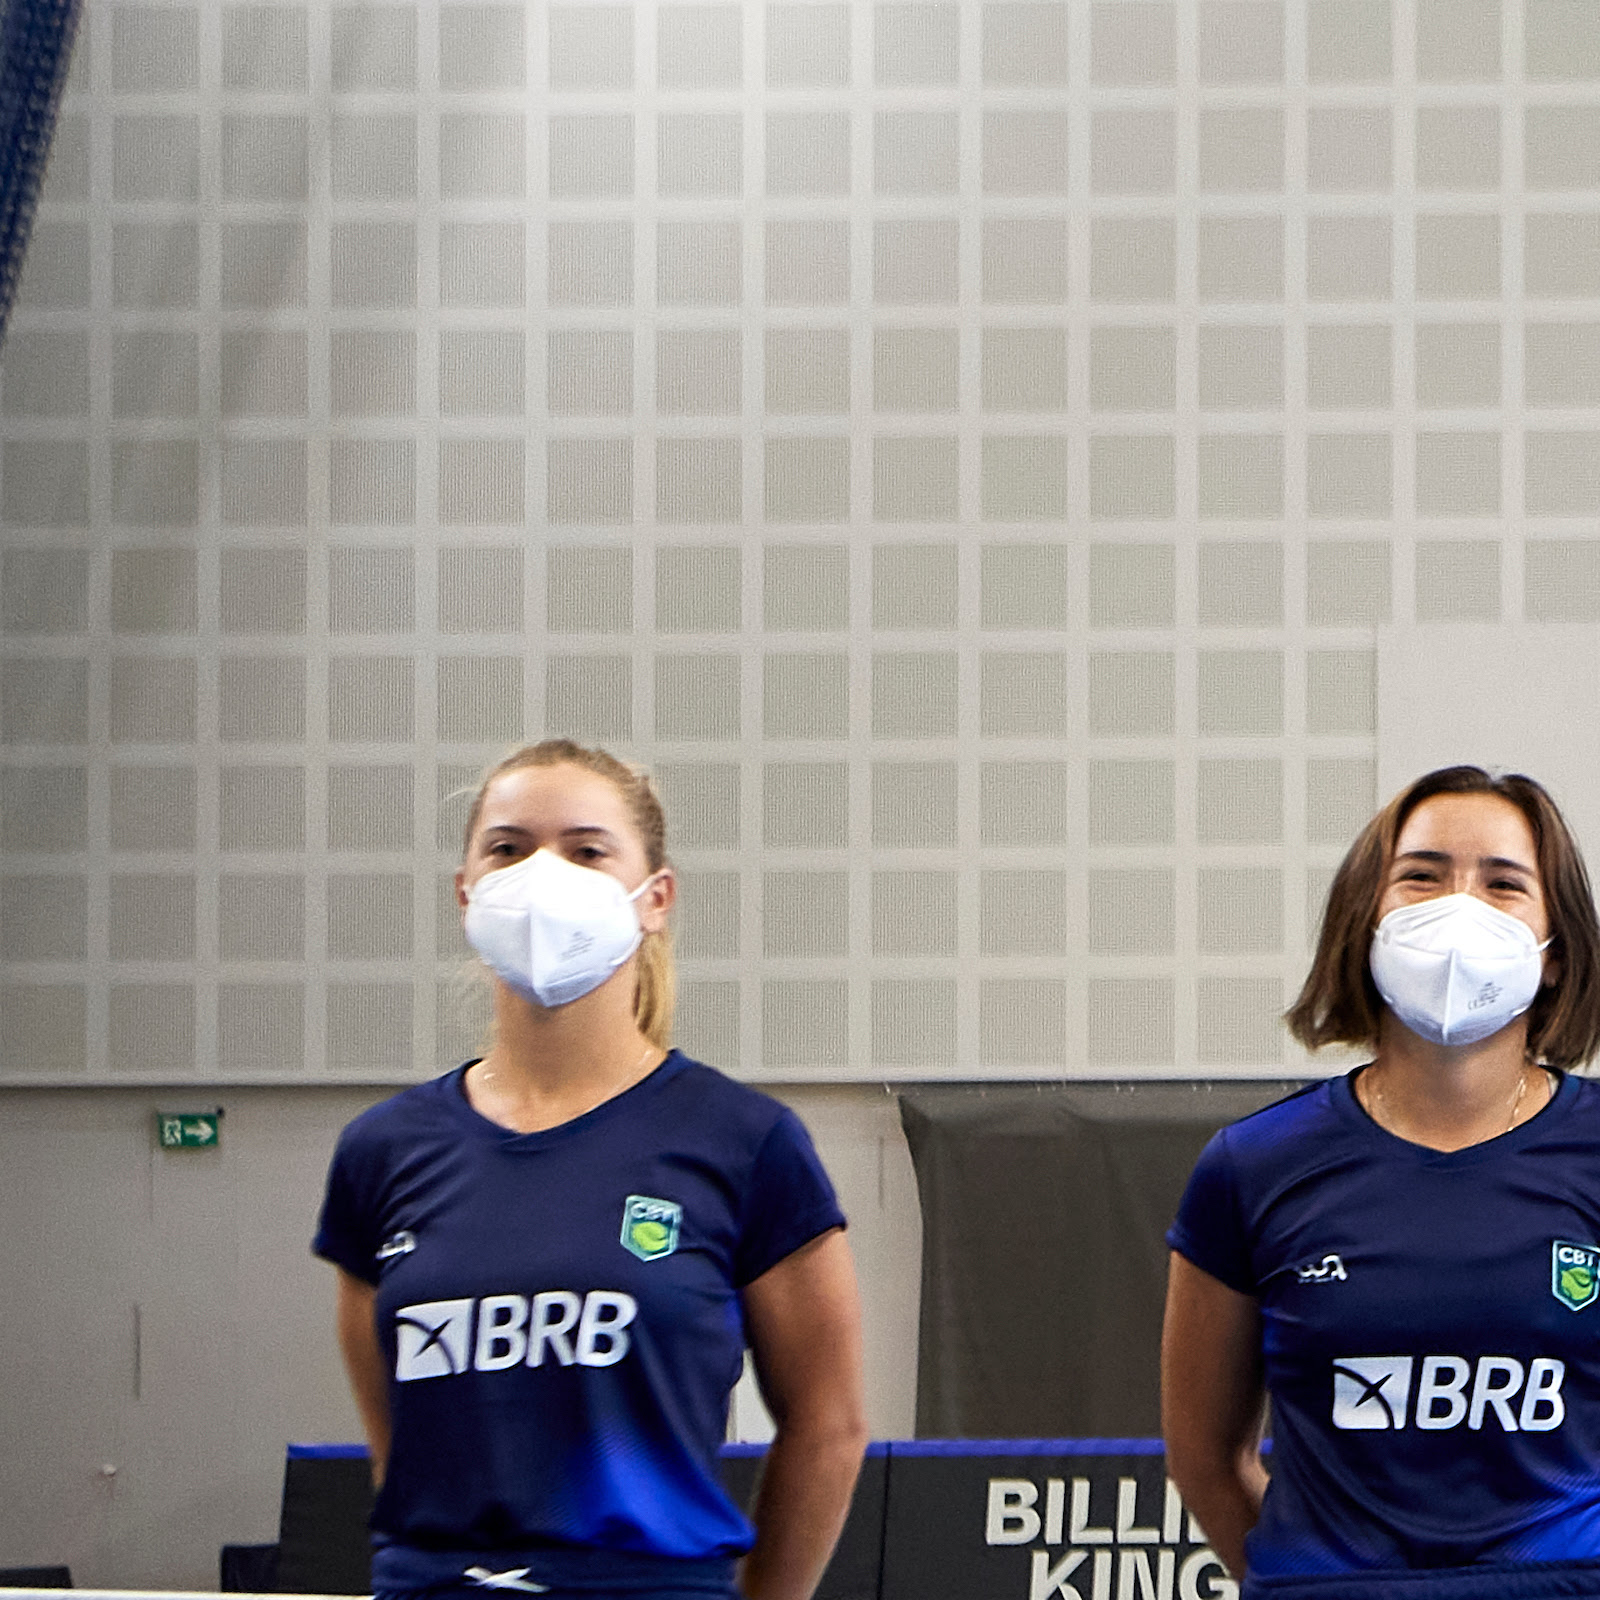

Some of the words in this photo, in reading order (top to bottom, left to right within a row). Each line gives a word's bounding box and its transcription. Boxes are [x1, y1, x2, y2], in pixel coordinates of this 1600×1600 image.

[1559, 1246, 1596, 1267] CBT
[474, 1290, 638, 1372] BRB
[1415, 1355, 1566, 1432] BRB
